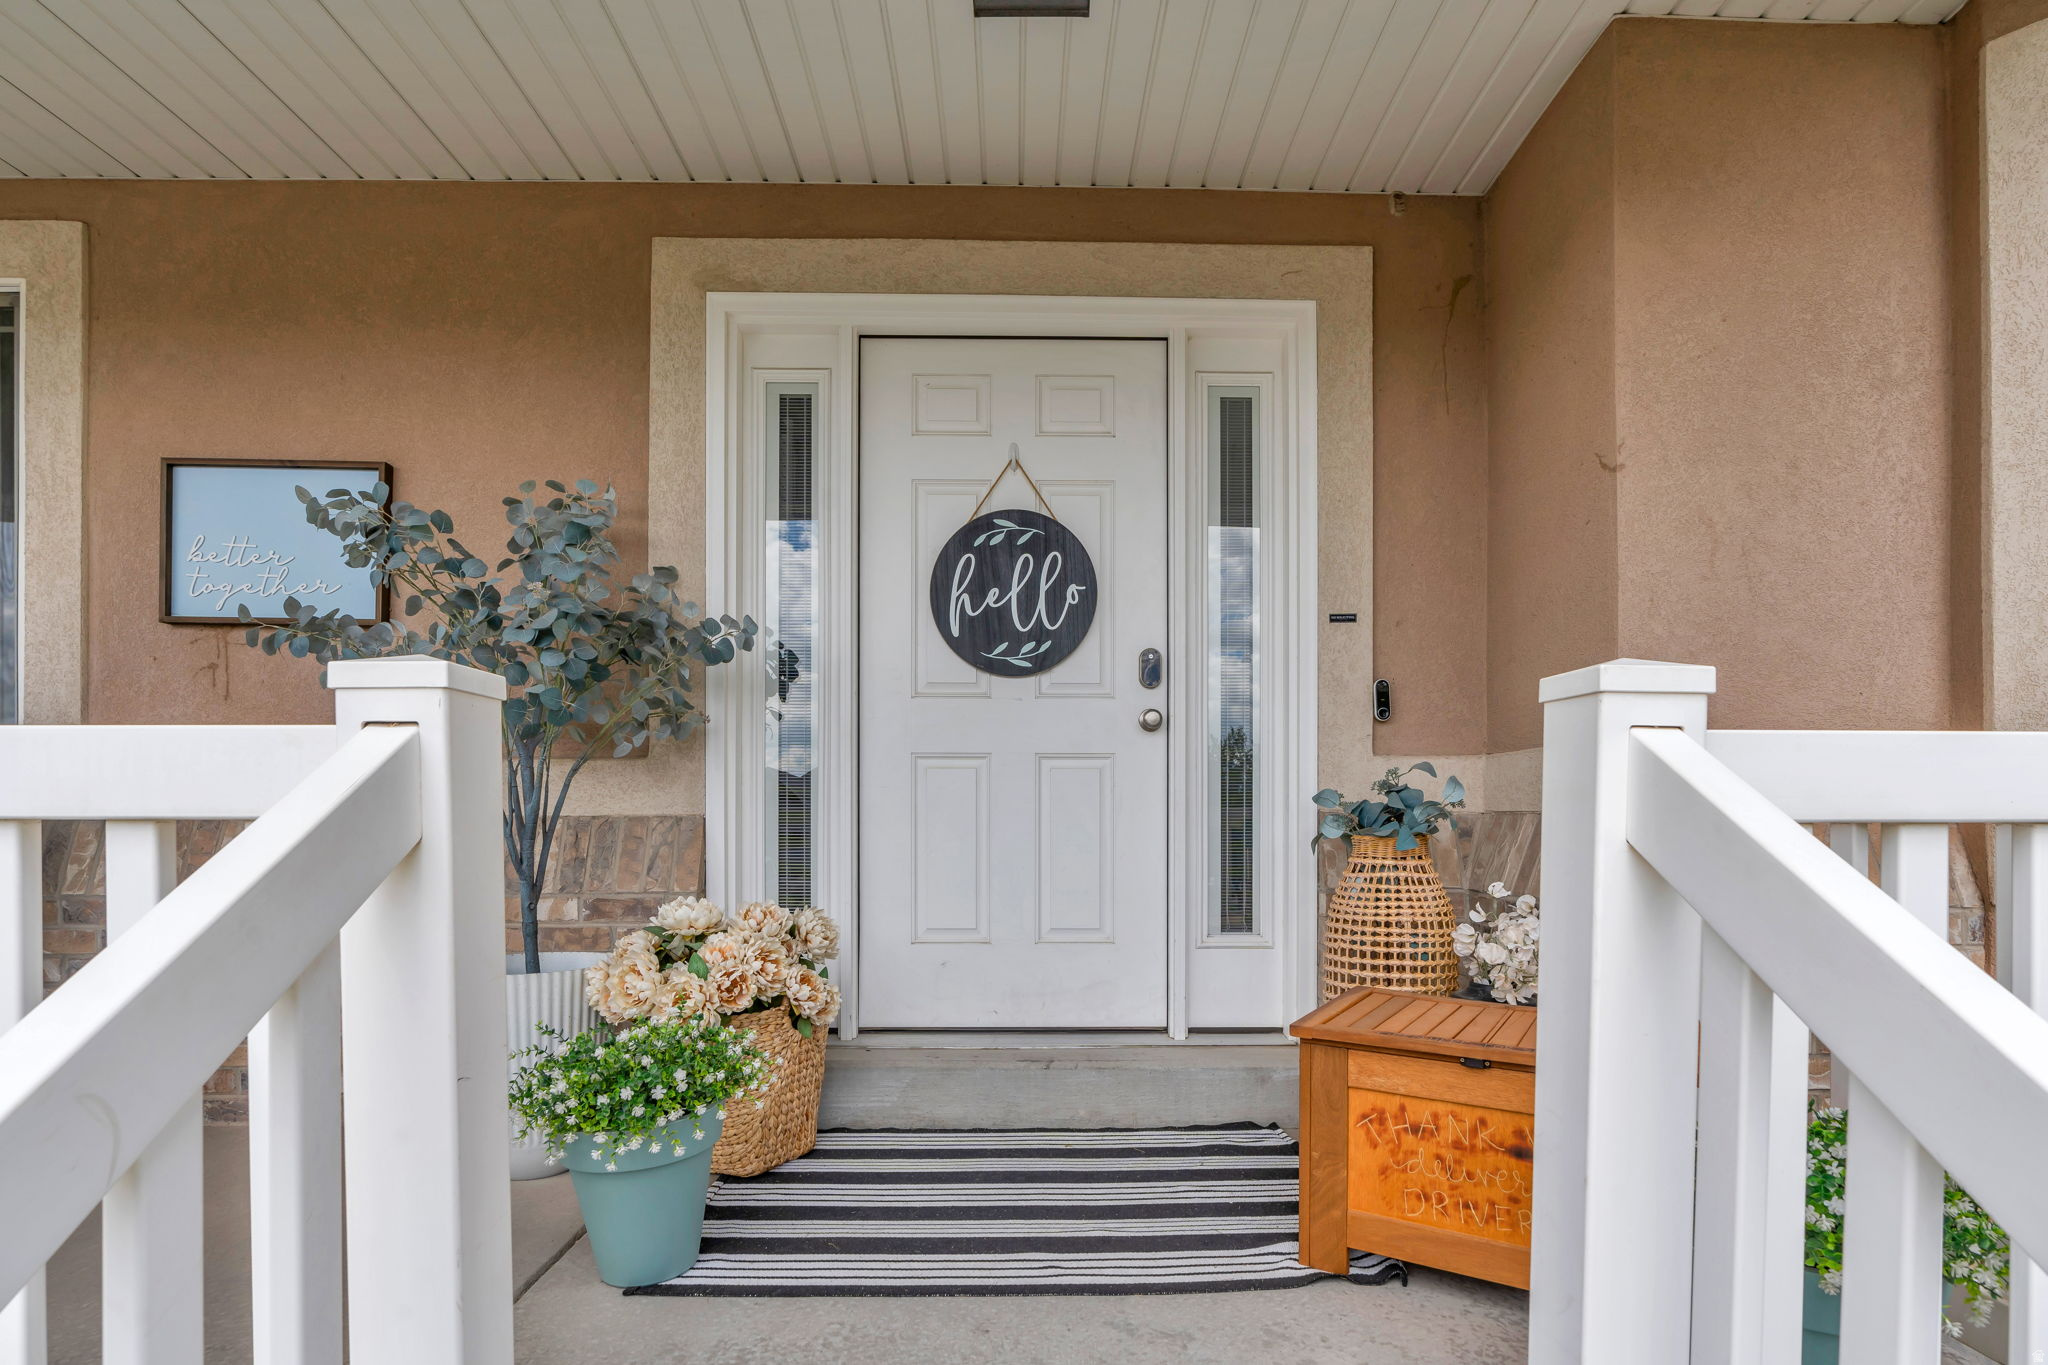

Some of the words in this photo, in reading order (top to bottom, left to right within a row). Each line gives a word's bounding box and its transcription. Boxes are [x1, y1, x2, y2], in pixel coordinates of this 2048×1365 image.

[187, 535, 295, 567] better
[186, 566, 343, 611] together
[950, 551, 1086, 638] hello
[1356, 1110, 1506, 1151] THANK
[1403, 1187, 1532, 1235] DRIVER
